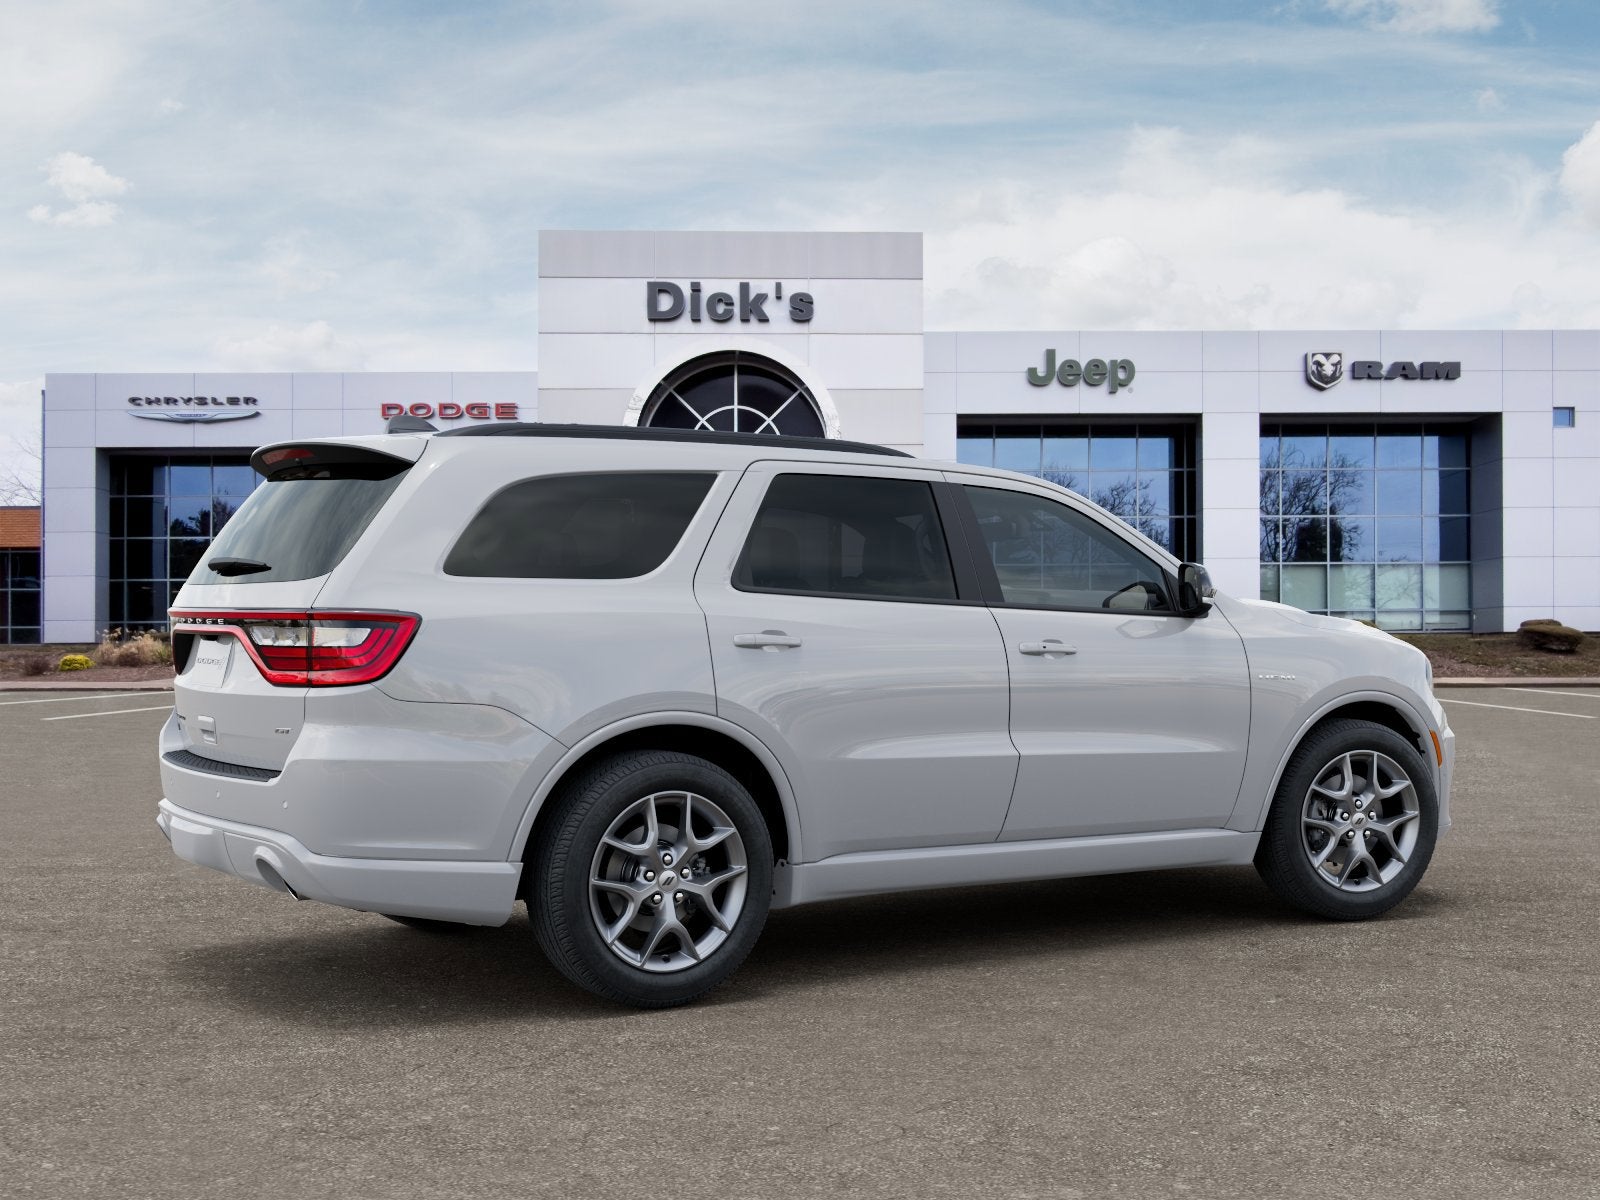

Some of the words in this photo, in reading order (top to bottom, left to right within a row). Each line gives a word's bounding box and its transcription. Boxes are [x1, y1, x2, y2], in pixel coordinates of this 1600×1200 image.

[647, 281, 815, 322] Dick's
[1027, 348, 1136, 394] Jeep
[1351, 360, 1461, 380] RAM
[127, 396, 258, 406] CHRYSLER
[381, 402, 519, 420] DODGE
